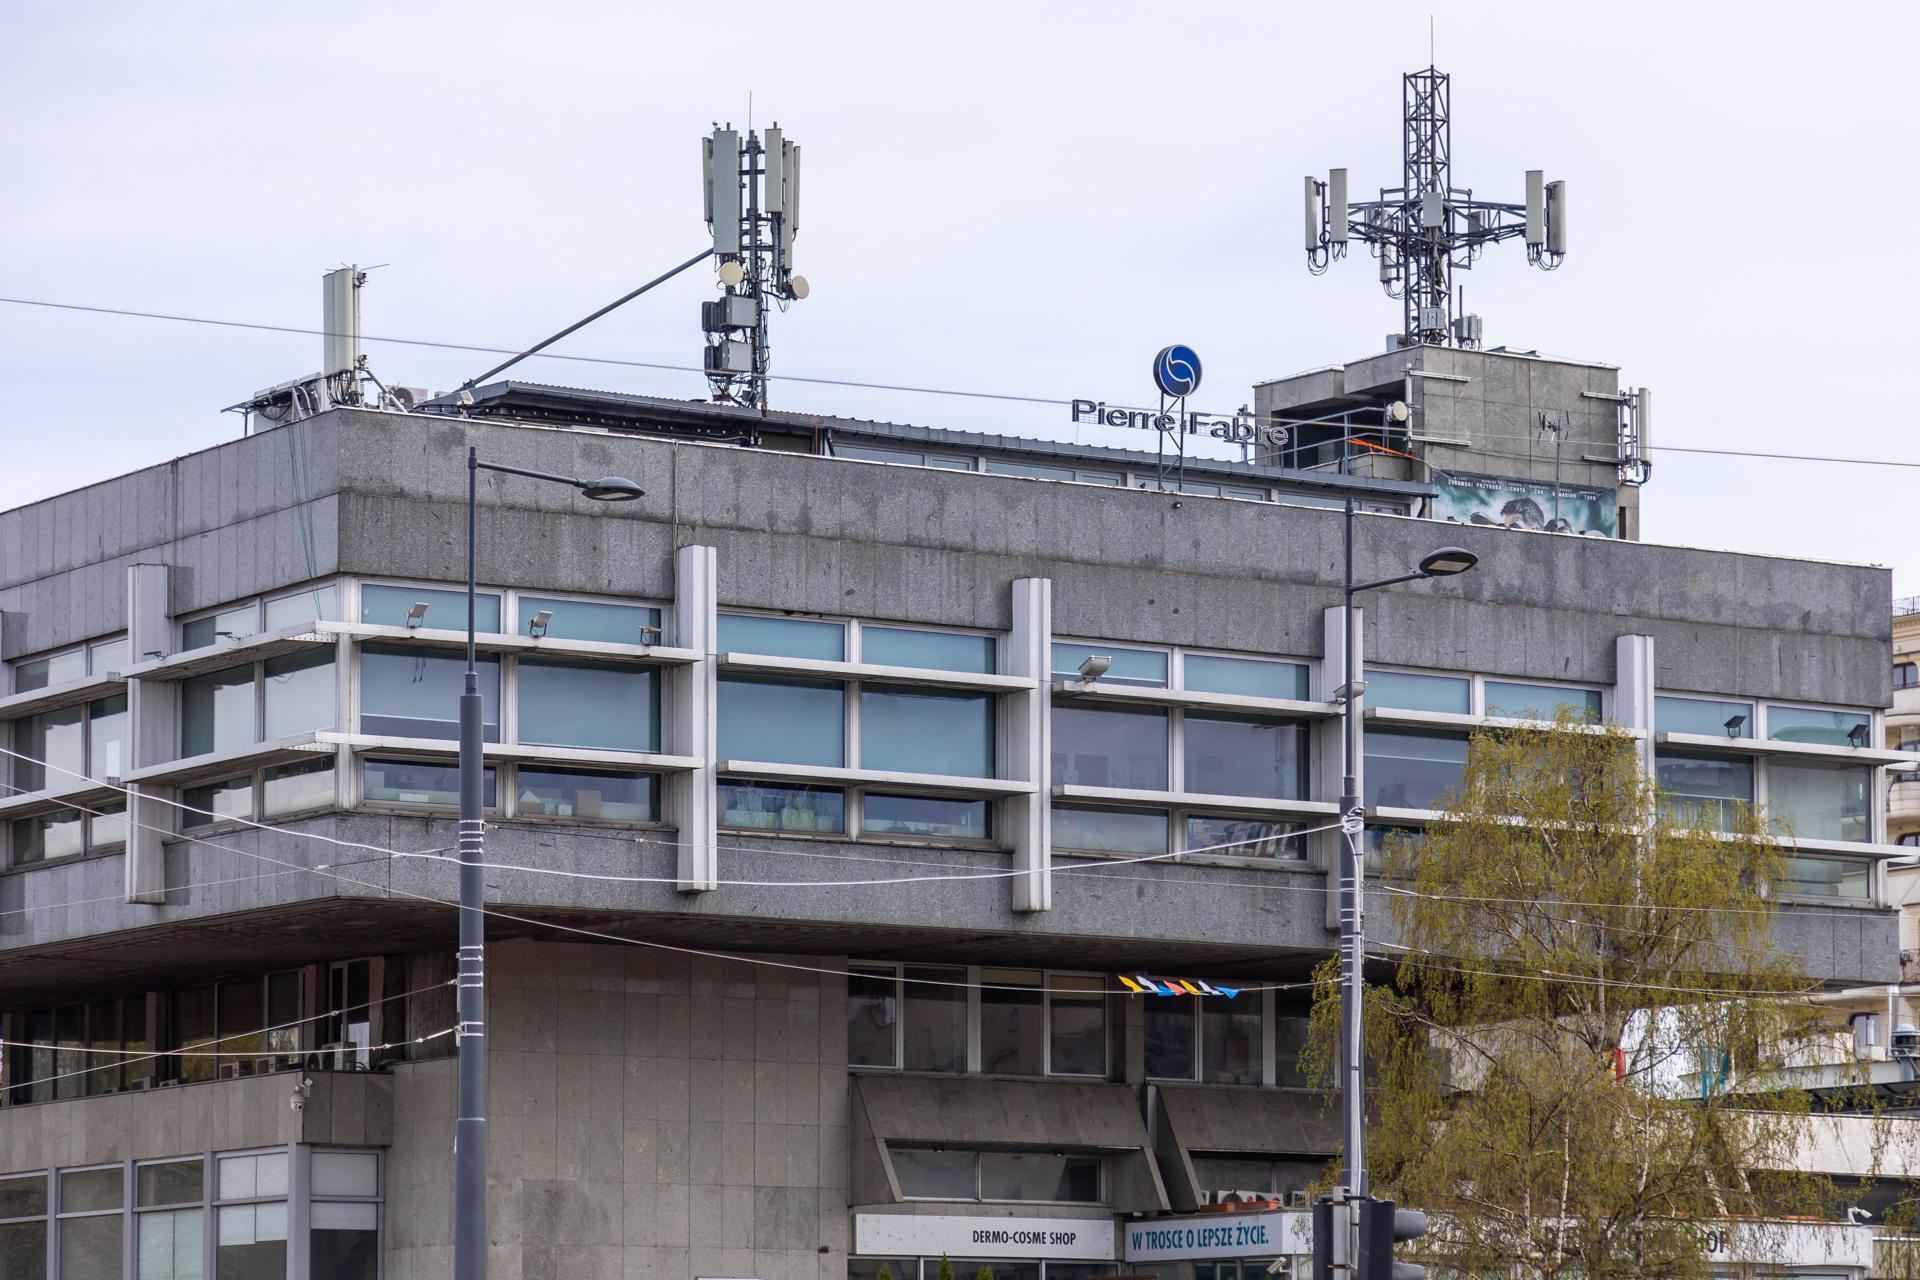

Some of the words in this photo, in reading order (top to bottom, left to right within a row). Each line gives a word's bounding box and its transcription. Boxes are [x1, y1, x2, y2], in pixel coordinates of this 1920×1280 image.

[1071, 398, 1176, 432] Pierre
[1189, 411, 1289, 446] Fabre
[972, 1230, 1047, 1245] DERMO-COSME
[1049, 1232, 1077, 1246] SHOP
[1132, 1231, 1142, 1251] W
[1145, 1230, 1183, 1250] TROSCE
[1186, 1229, 1195, 1249] O
[1197, 1227, 1233, 1247] LEPSZE
[1236, 1221, 1269, 1246] ŻYCIE.
